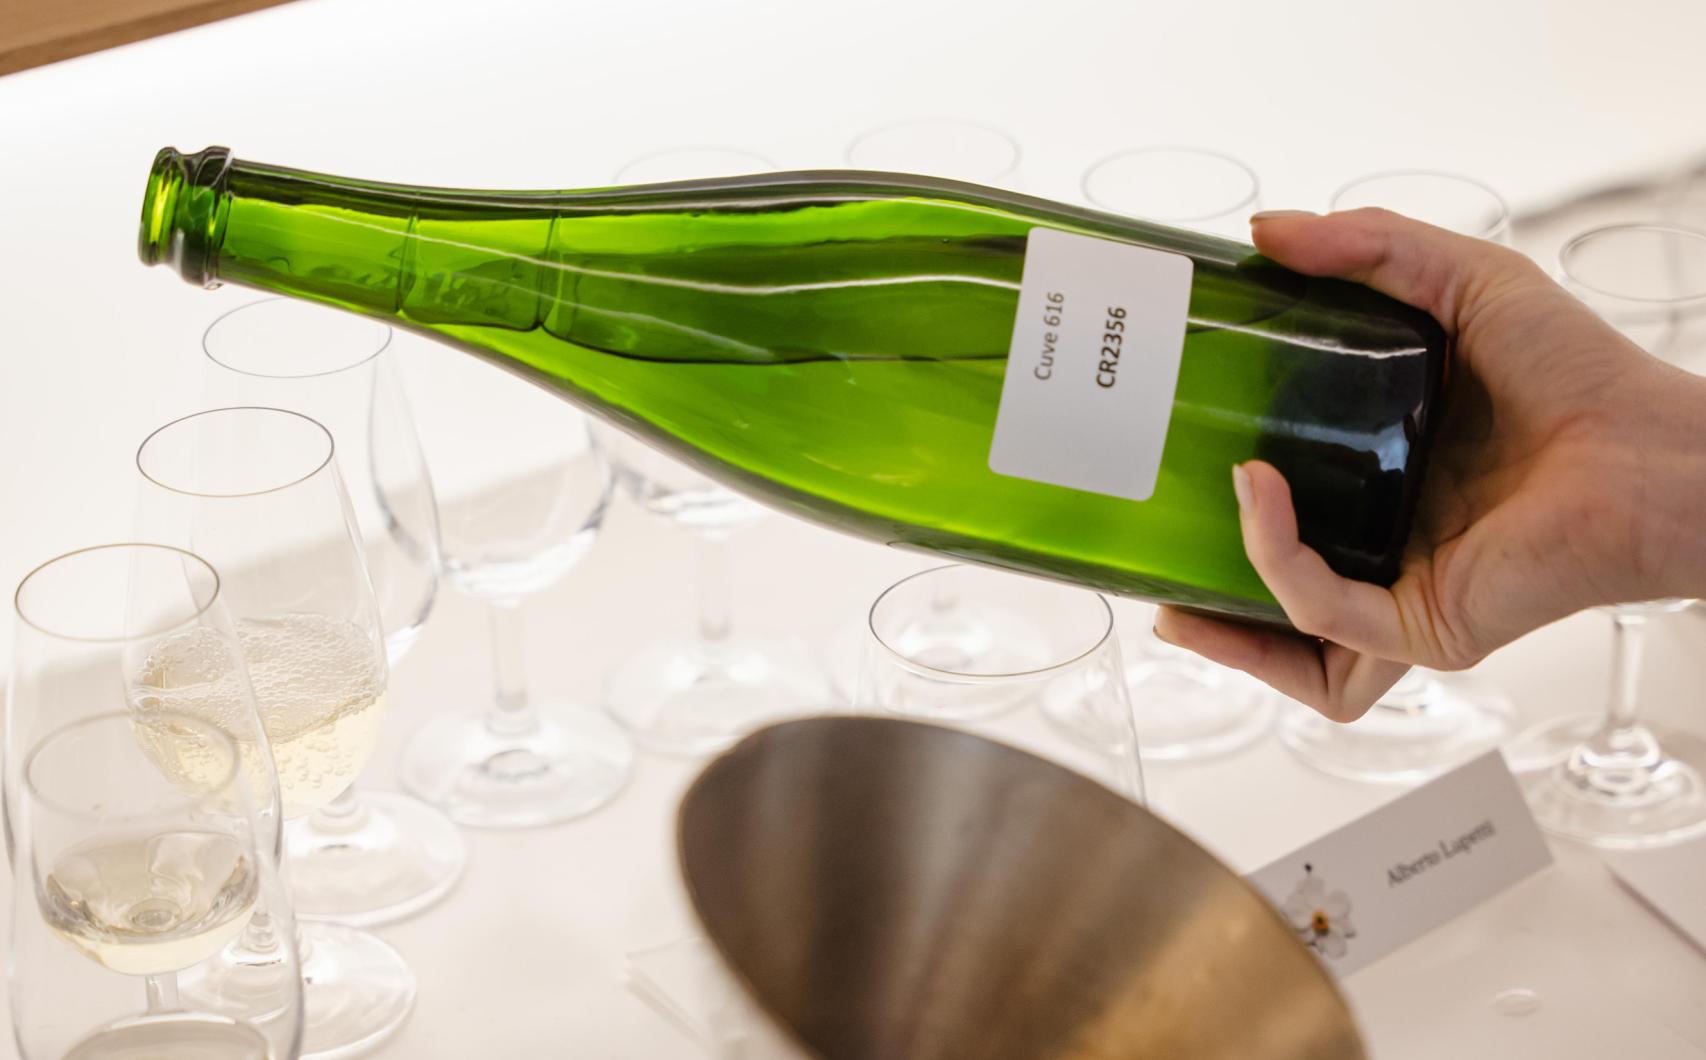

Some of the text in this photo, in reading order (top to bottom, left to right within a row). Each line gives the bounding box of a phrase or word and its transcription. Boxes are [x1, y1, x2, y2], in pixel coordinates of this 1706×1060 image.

[1034, 292, 1064, 381] Cuve 616
[1096, 307, 1127, 389] CR2356
[1387, 851, 1441, 888] Alberto
